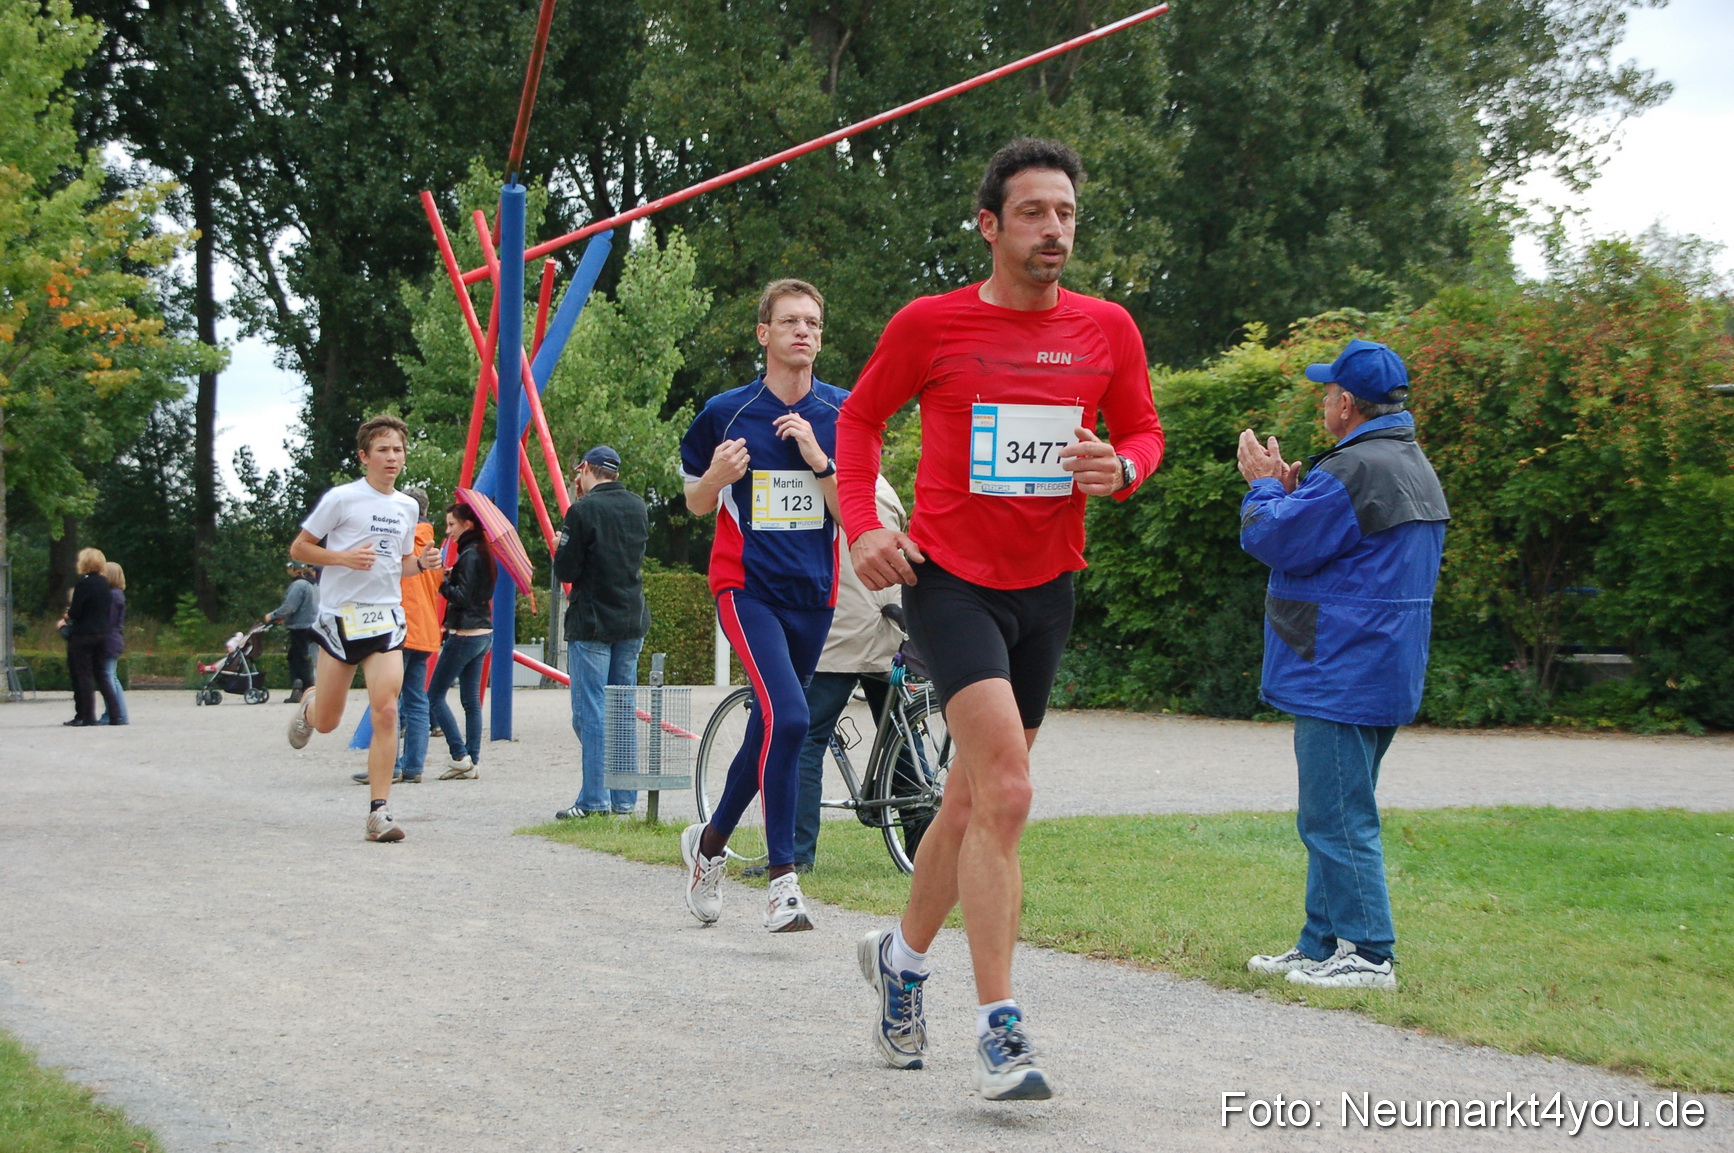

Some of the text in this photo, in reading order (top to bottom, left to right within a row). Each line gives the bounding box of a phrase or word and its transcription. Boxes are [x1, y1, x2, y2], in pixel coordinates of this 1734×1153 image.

[1036, 351, 1072, 365] RUN
[1006, 441, 1068, 464] 3477
[773, 477, 803, 488] Martin
[1036, 483, 1071, 491] PFLEIDERER
[781, 495, 813, 511] 123
[362, 611, 384, 624] 224
